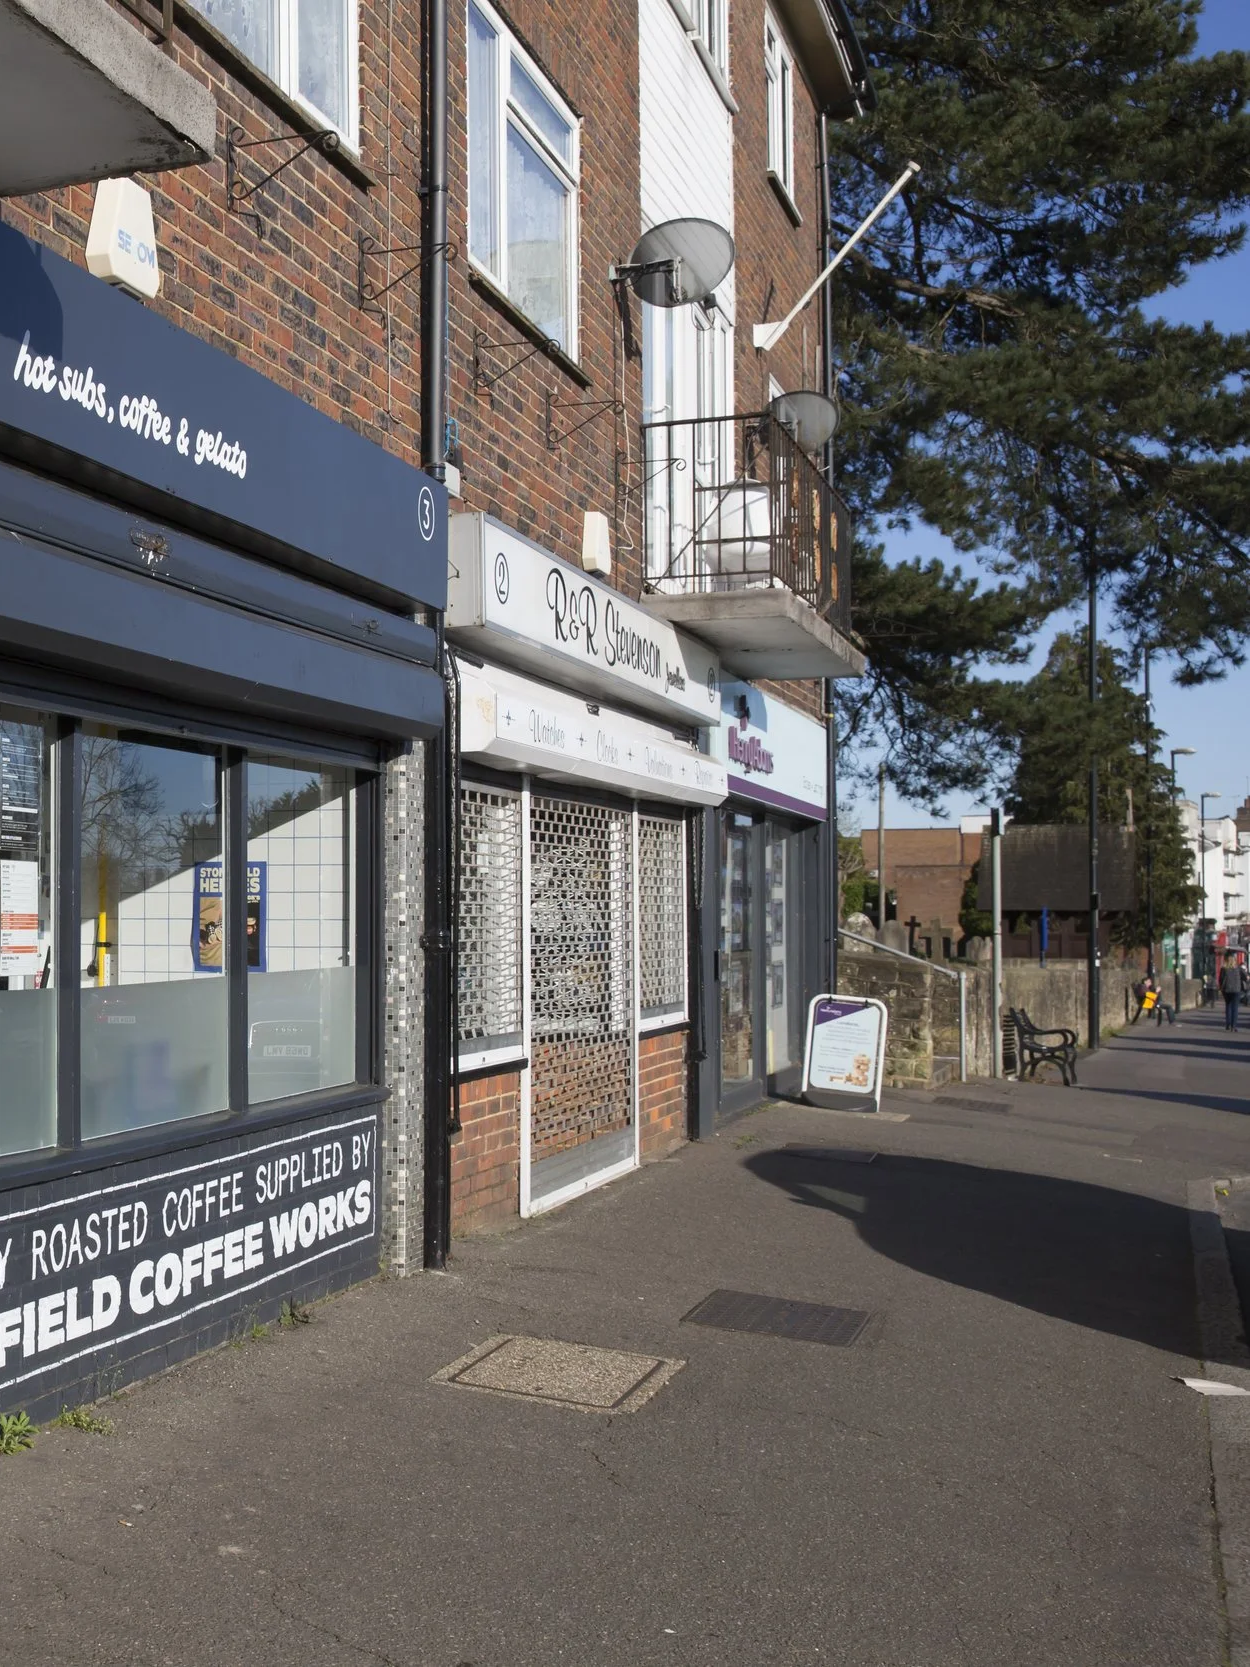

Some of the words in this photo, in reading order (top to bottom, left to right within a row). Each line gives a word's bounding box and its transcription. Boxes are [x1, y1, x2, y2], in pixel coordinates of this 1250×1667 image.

[13, 330, 57, 393] hot
[58, 365, 114, 424] subs,
[119, 395, 171, 445] coffee
[176, 418, 189, 456] &
[194, 428, 247, 479] gelato
[605, 599, 661, 679] Stevenson
[528, 708, 565, 749] Watches
[31, 1201, 148, 1281] ROASTED
[162, 1171, 244, 1237] COFFEE
[255, 1141, 343, 1204] SUPPLIED
[352, 1131, 371, 1171] BY
[129, 1221, 264, 1315] COFFEE
[269, 1179, 371, 1259] WORKS
